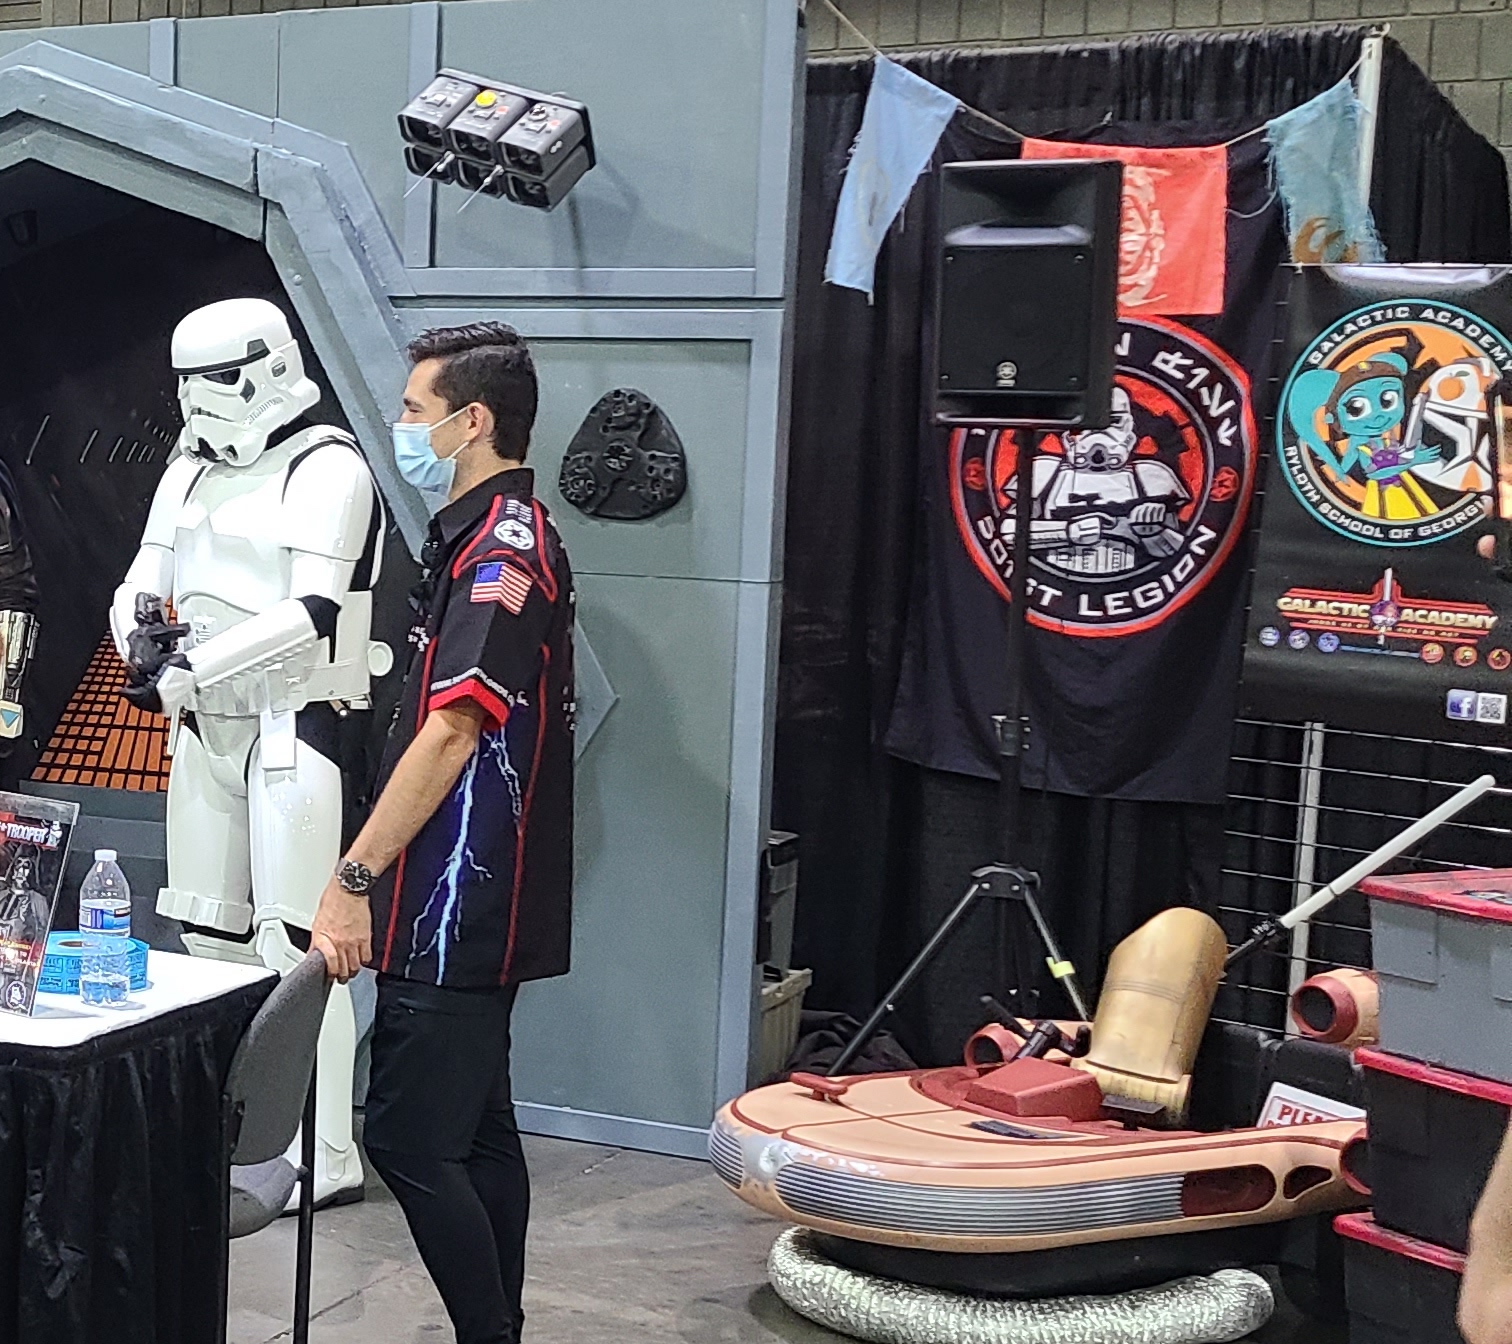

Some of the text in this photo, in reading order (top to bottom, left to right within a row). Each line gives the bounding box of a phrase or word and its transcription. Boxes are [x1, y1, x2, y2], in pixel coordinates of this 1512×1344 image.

[1307, 306, 1512, 373] GALACTIC ACADEMY
[1284, 444, 1321, 508] RYLOTH
[1317, 501, 1385, 539] SCHOOL
[1387, 527, 1414, 540] OF
[1077, 523, 1217, 617] LEGION
[1276, 596, 1371, 619] GALACTIC
[1399, 607, 1499, 630] ACADEMY
[1276, 1103, 1326, 1126] PLEA
